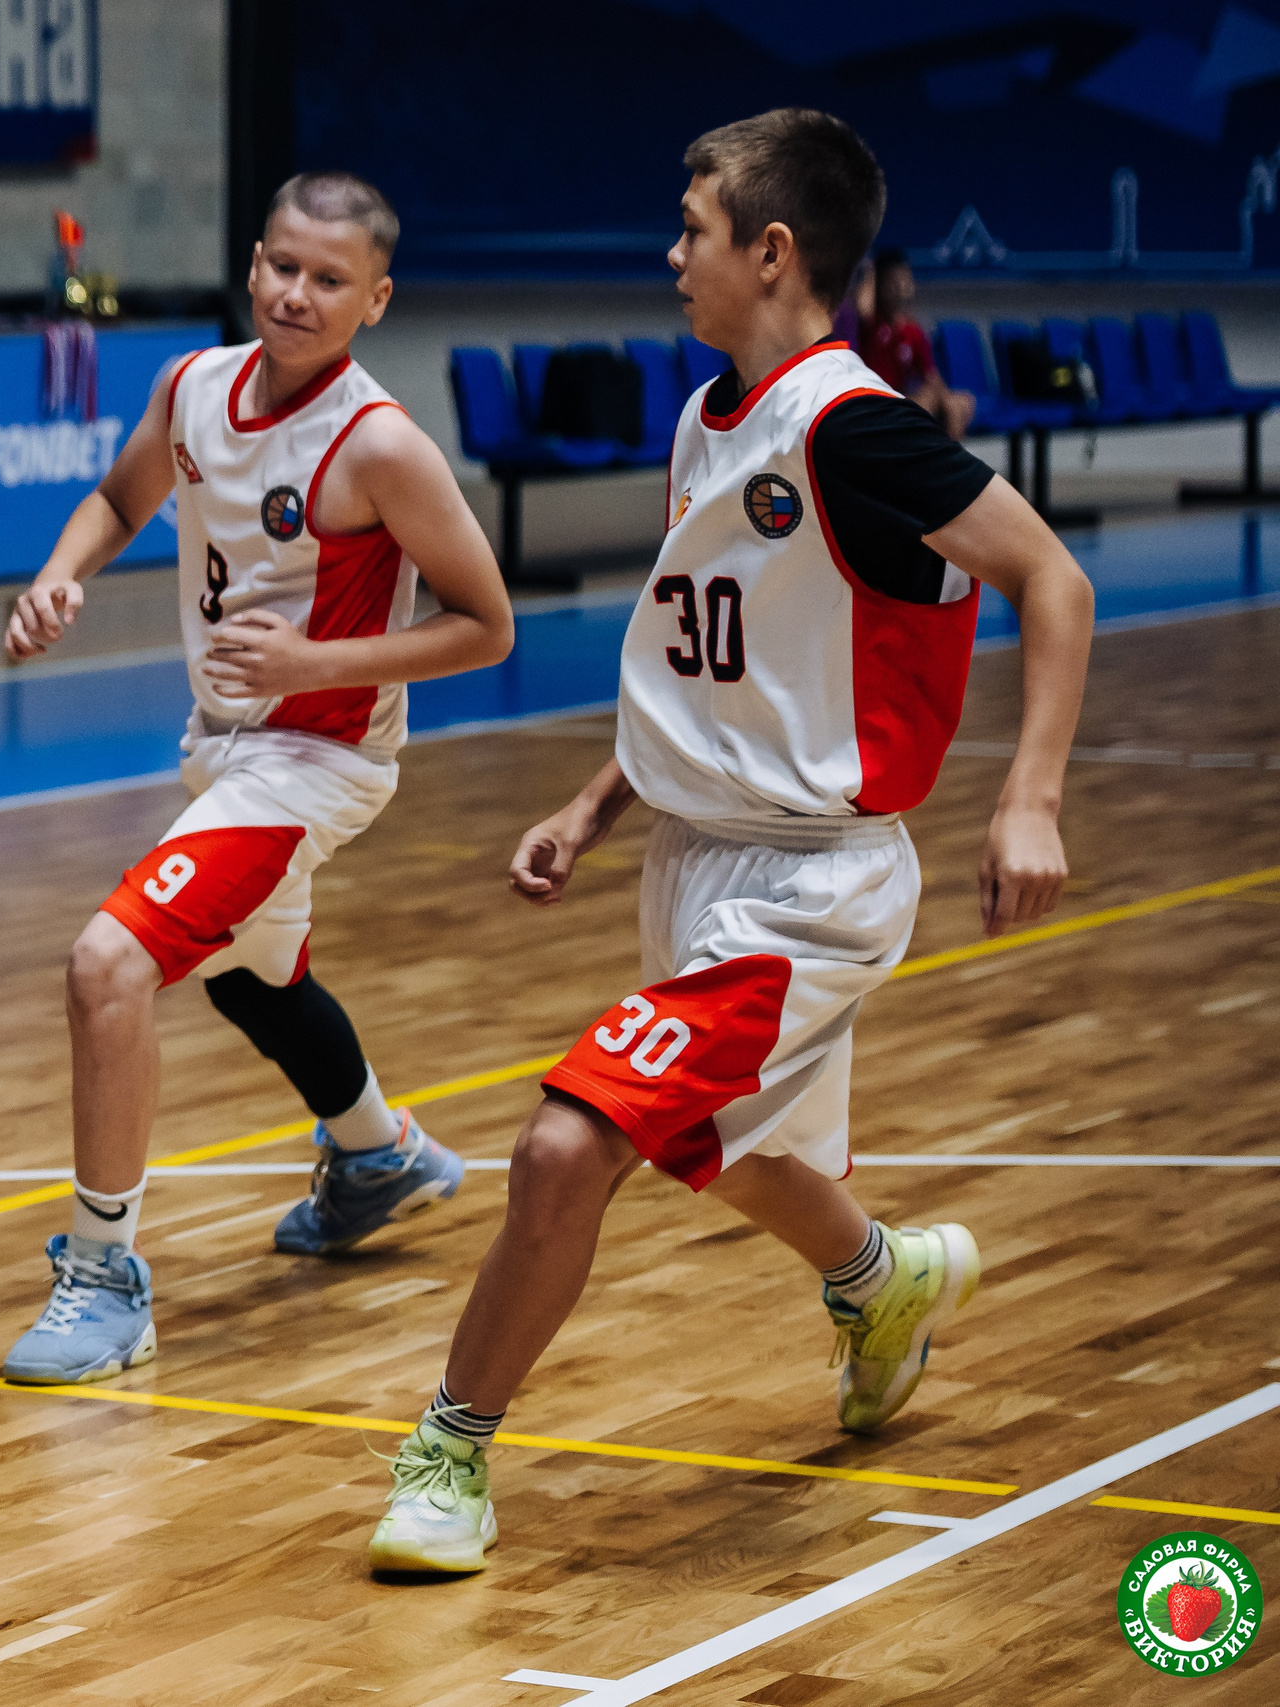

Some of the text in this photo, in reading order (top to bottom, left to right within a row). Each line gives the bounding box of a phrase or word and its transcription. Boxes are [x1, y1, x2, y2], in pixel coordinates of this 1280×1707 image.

[652, 573, 746, 683] 30
[143, 852, 196, 905] 9
[595, 994, 691, 1078] 30
